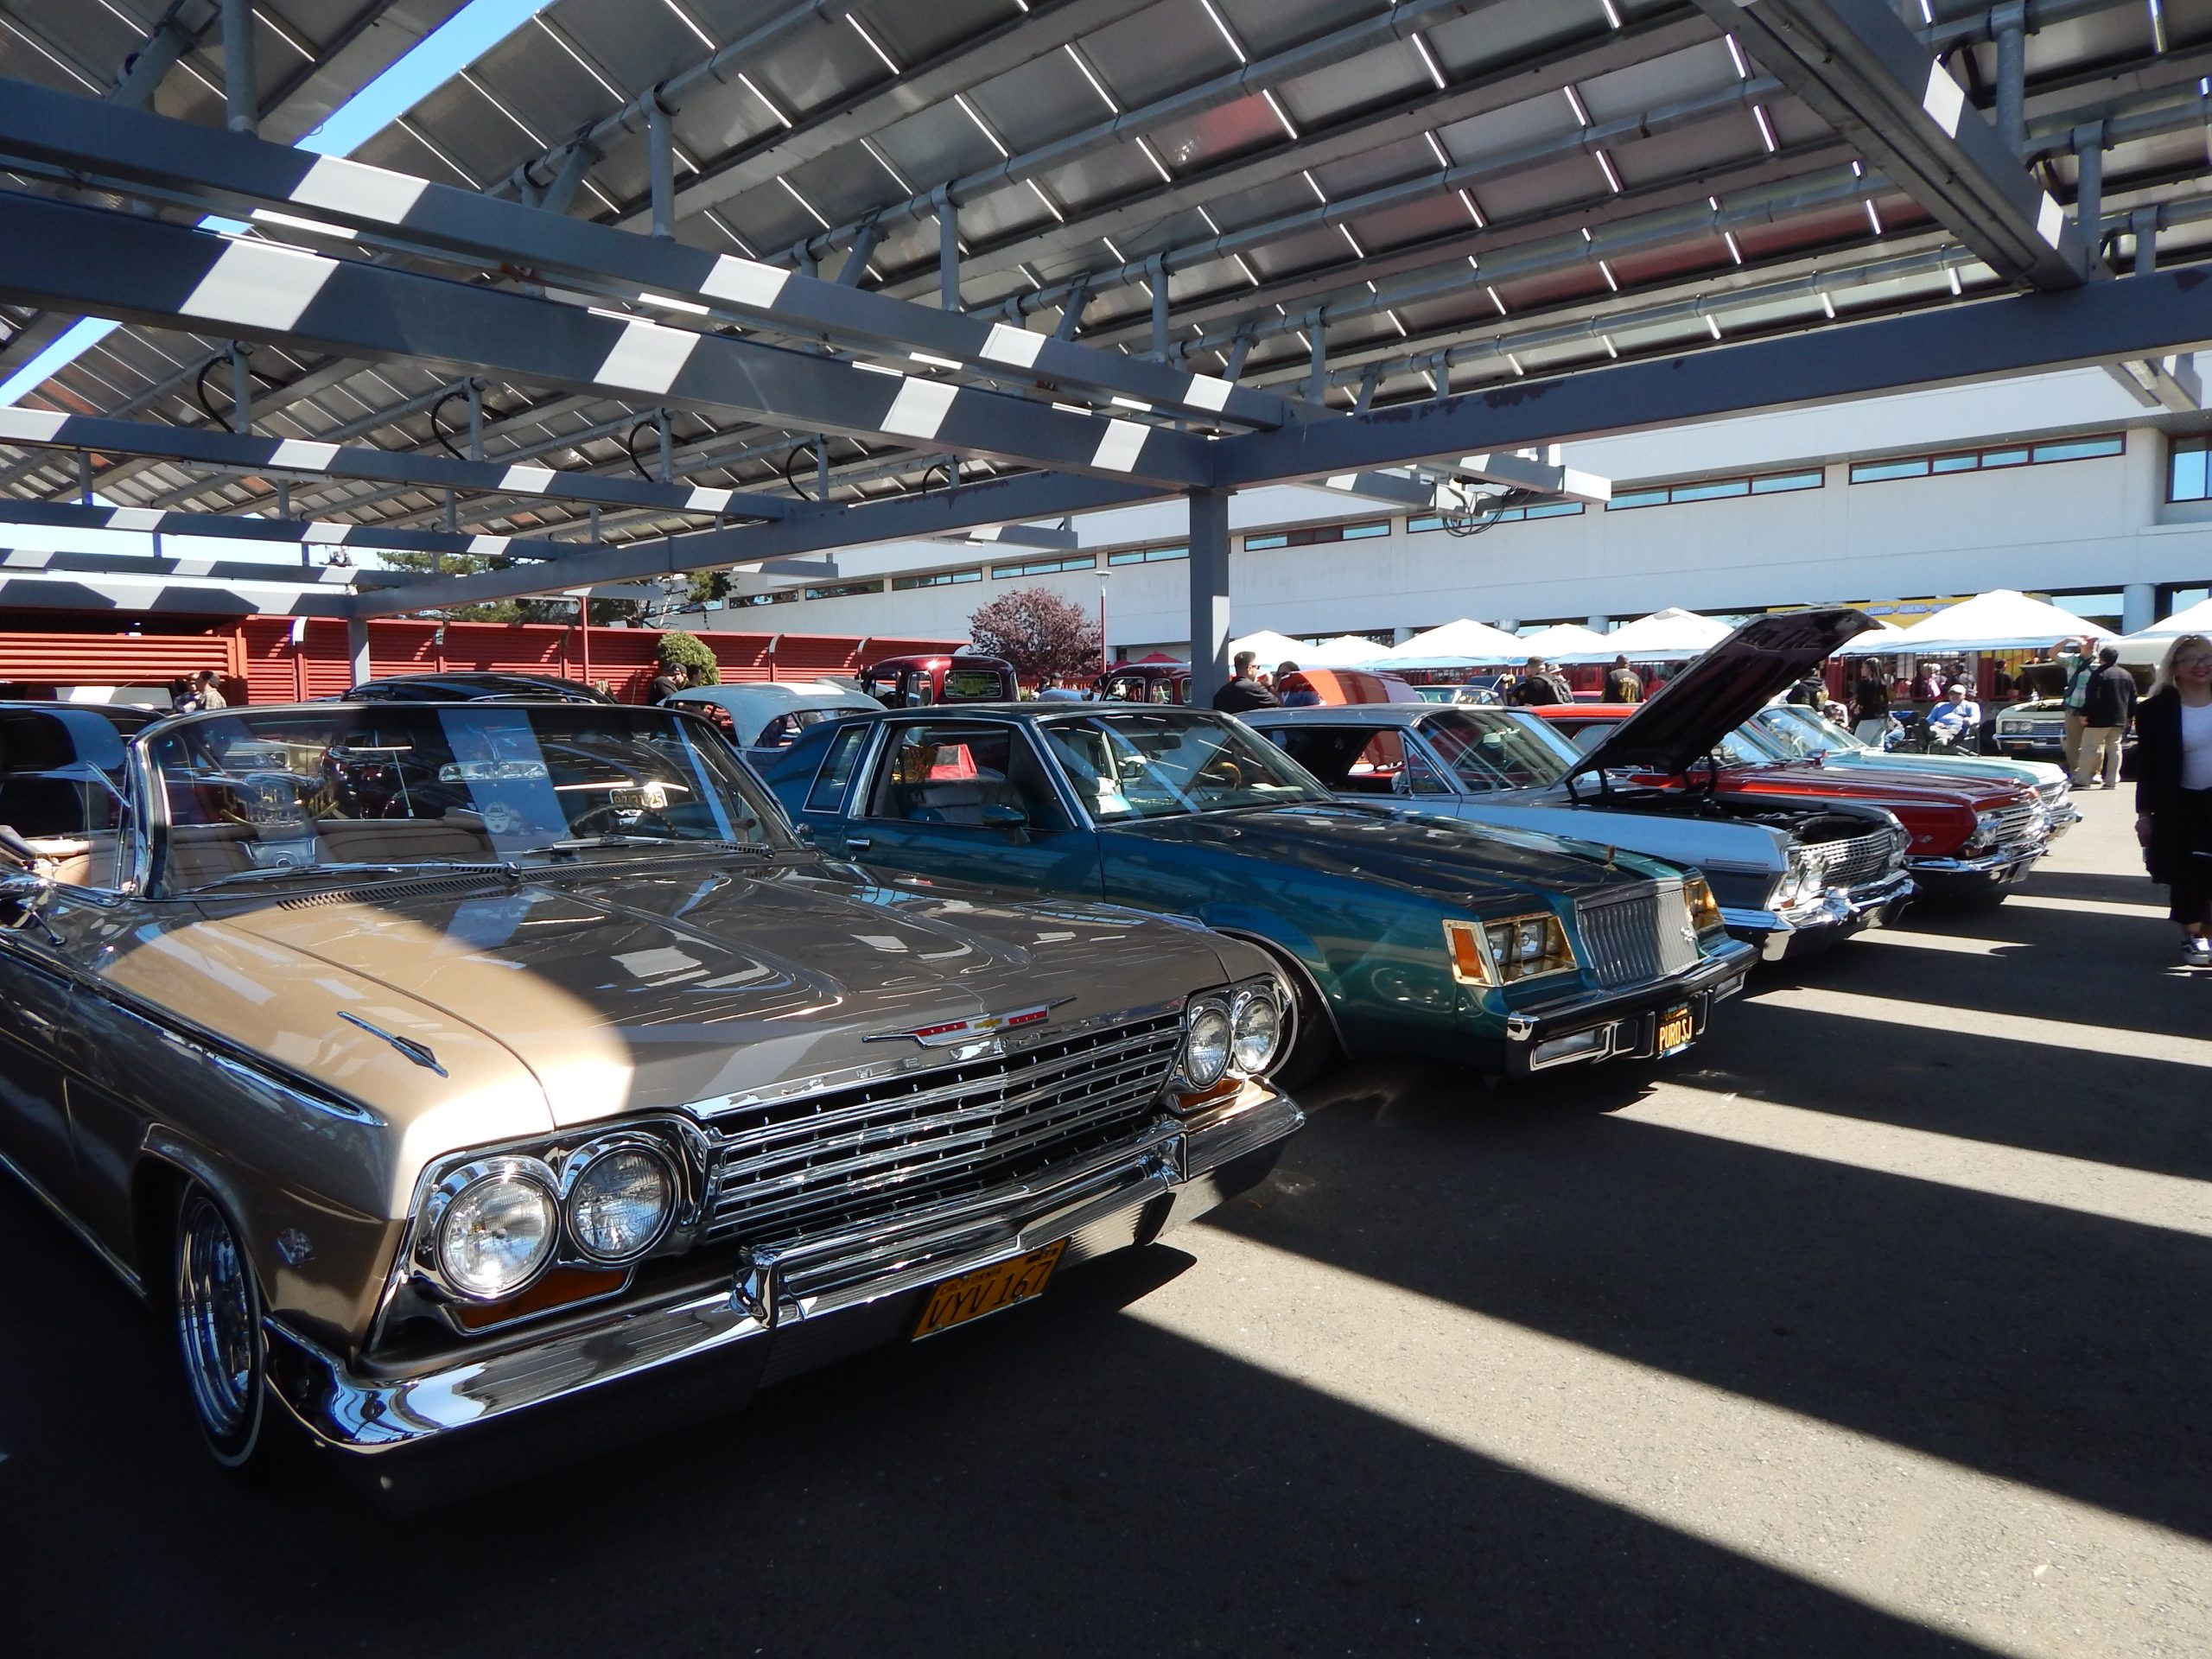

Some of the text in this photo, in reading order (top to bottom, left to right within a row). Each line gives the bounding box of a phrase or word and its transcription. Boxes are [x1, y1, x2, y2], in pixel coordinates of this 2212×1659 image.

[927, 1259, 1053, 1329] VYV 167
[939, 1267, 1002, 1295] CALFORNIA
